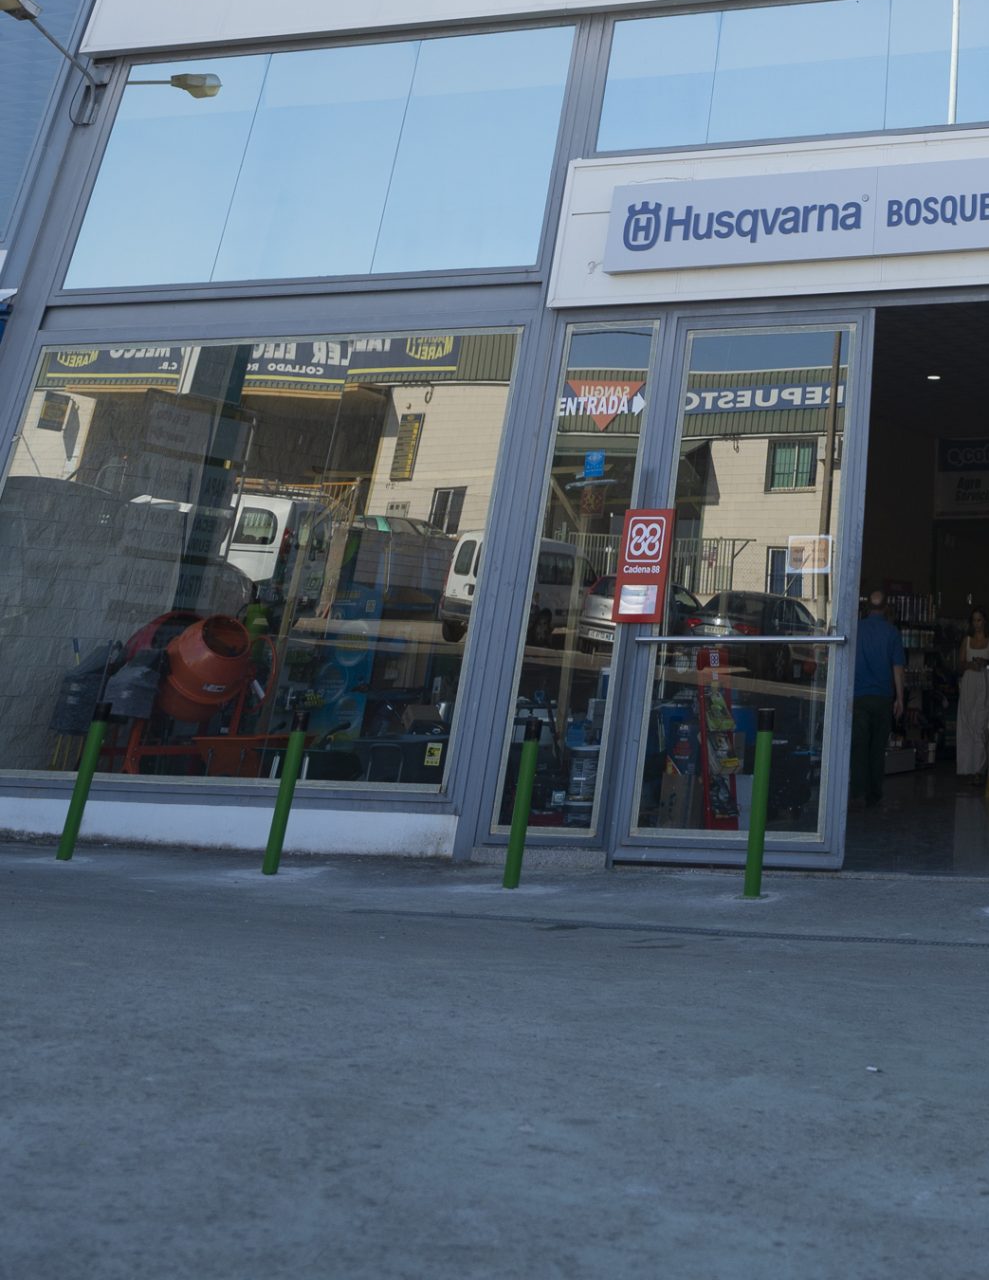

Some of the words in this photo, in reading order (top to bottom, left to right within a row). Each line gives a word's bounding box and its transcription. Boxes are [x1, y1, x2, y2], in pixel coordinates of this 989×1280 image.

[559, 395, 629, 416] ENTRADA
[623, 565, 650, 574] Cadena
[651, 565, 661, 574] 88
